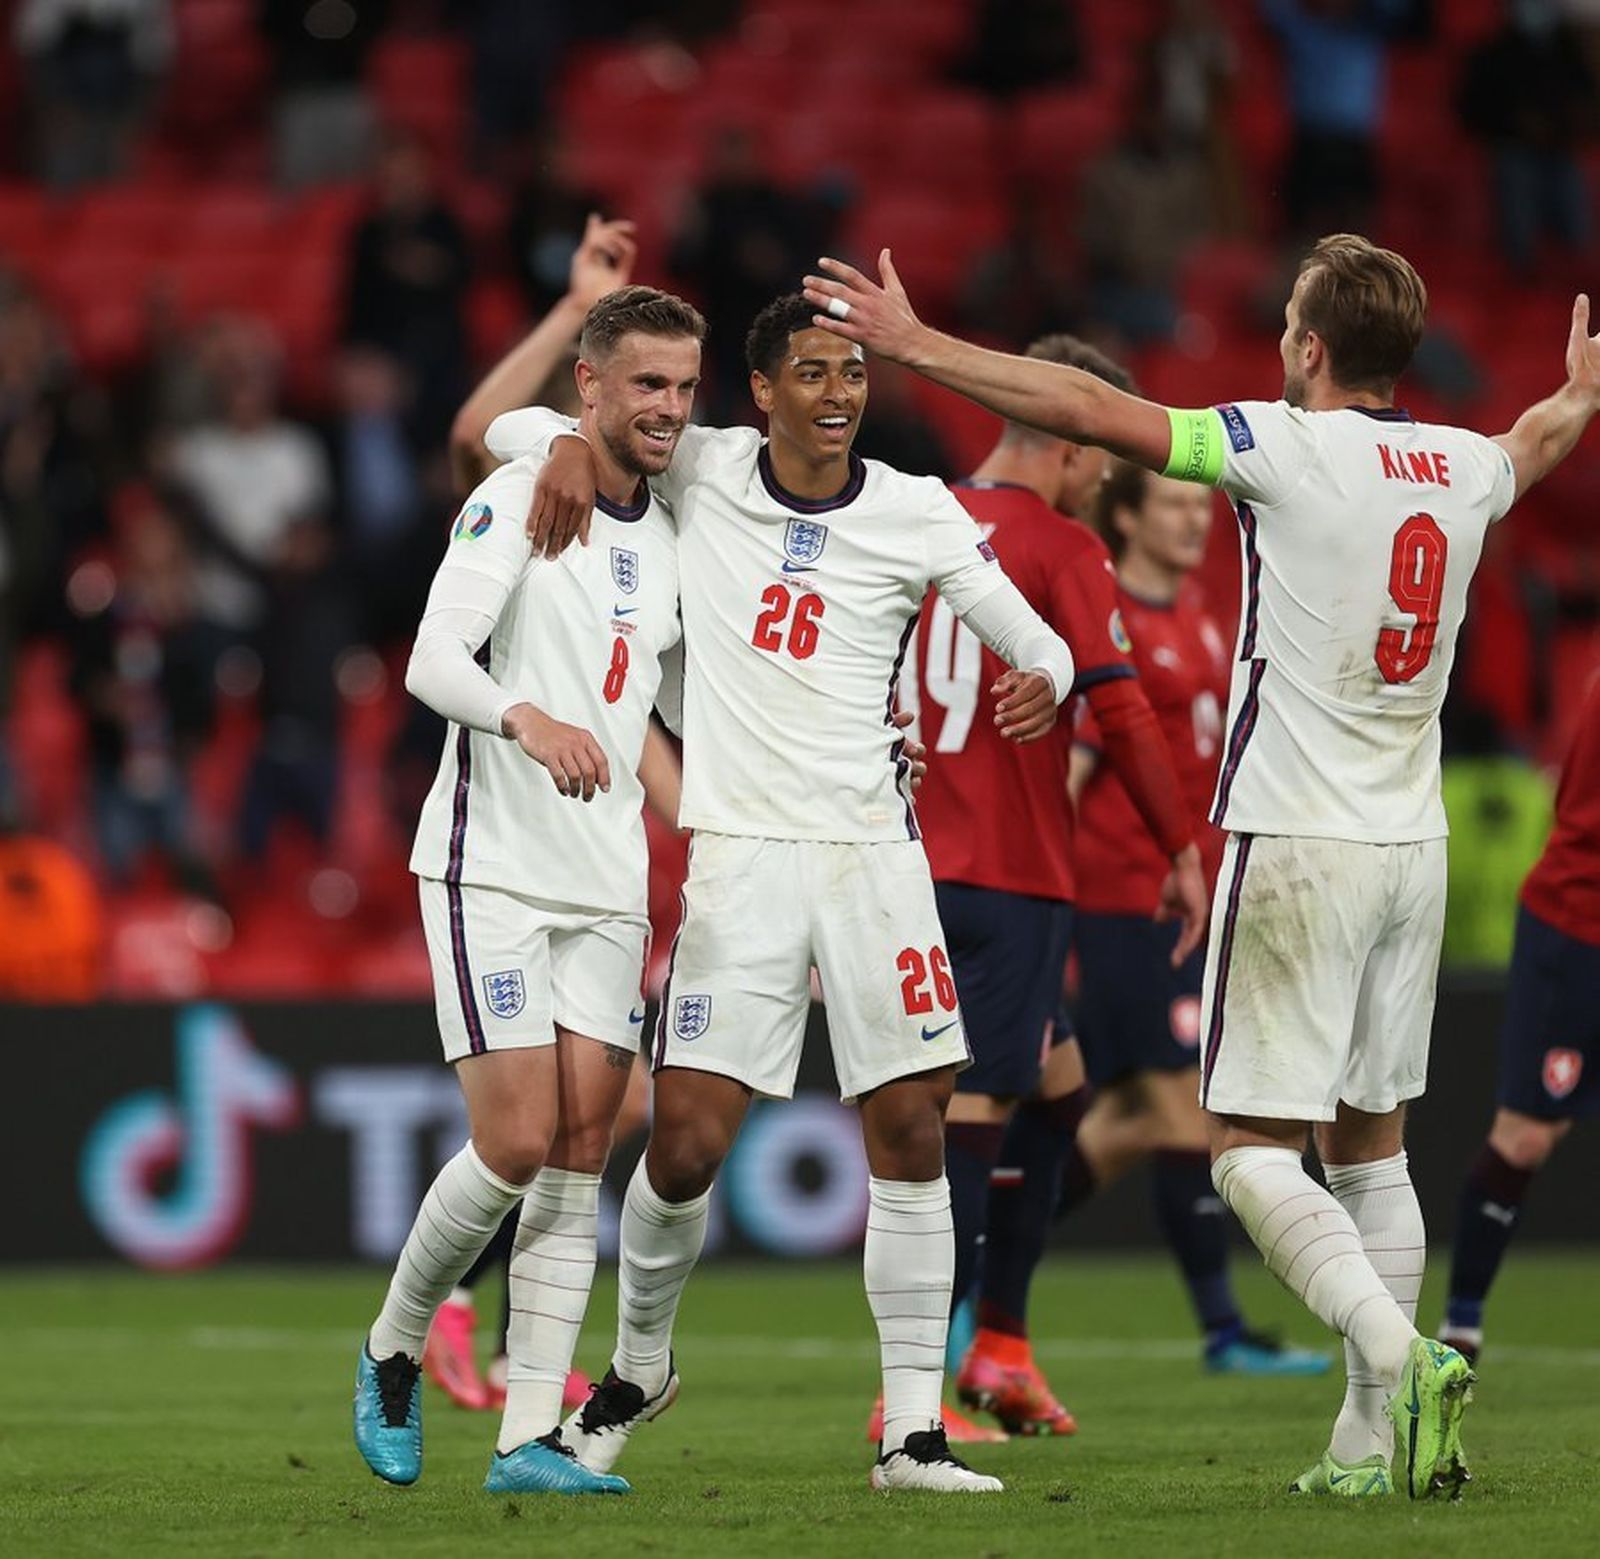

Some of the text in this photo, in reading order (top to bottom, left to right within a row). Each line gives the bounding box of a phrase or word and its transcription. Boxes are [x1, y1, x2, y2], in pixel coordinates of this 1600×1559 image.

[1375, 443, 1451, 488] KANE
[751, 583, 826, 661] 26
[1374, 512, 1448, 685] 9
[602, 636, 629, 704] 8
[896, 945, 958, 1016] 26
